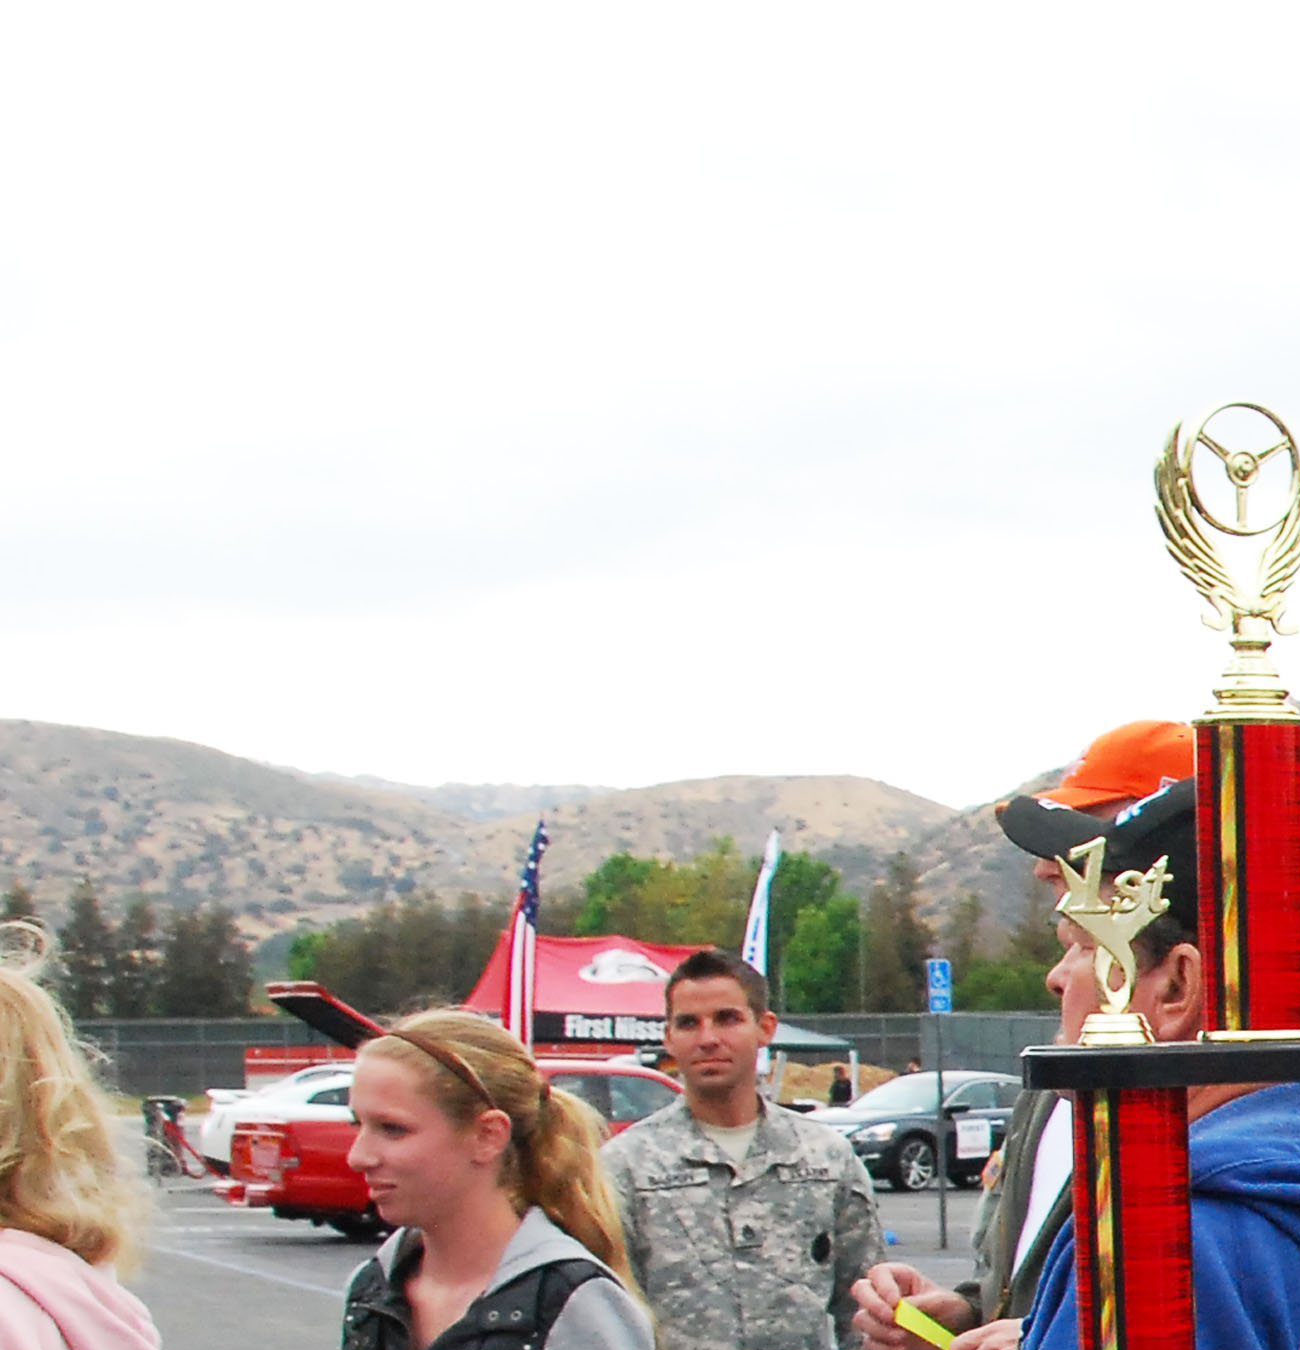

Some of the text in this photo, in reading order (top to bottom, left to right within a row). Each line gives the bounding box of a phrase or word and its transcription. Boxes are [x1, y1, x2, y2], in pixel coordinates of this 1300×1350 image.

[1064, 836, 1173, 914] 1st
[564, 1014, 666, 1040] First Nissa
